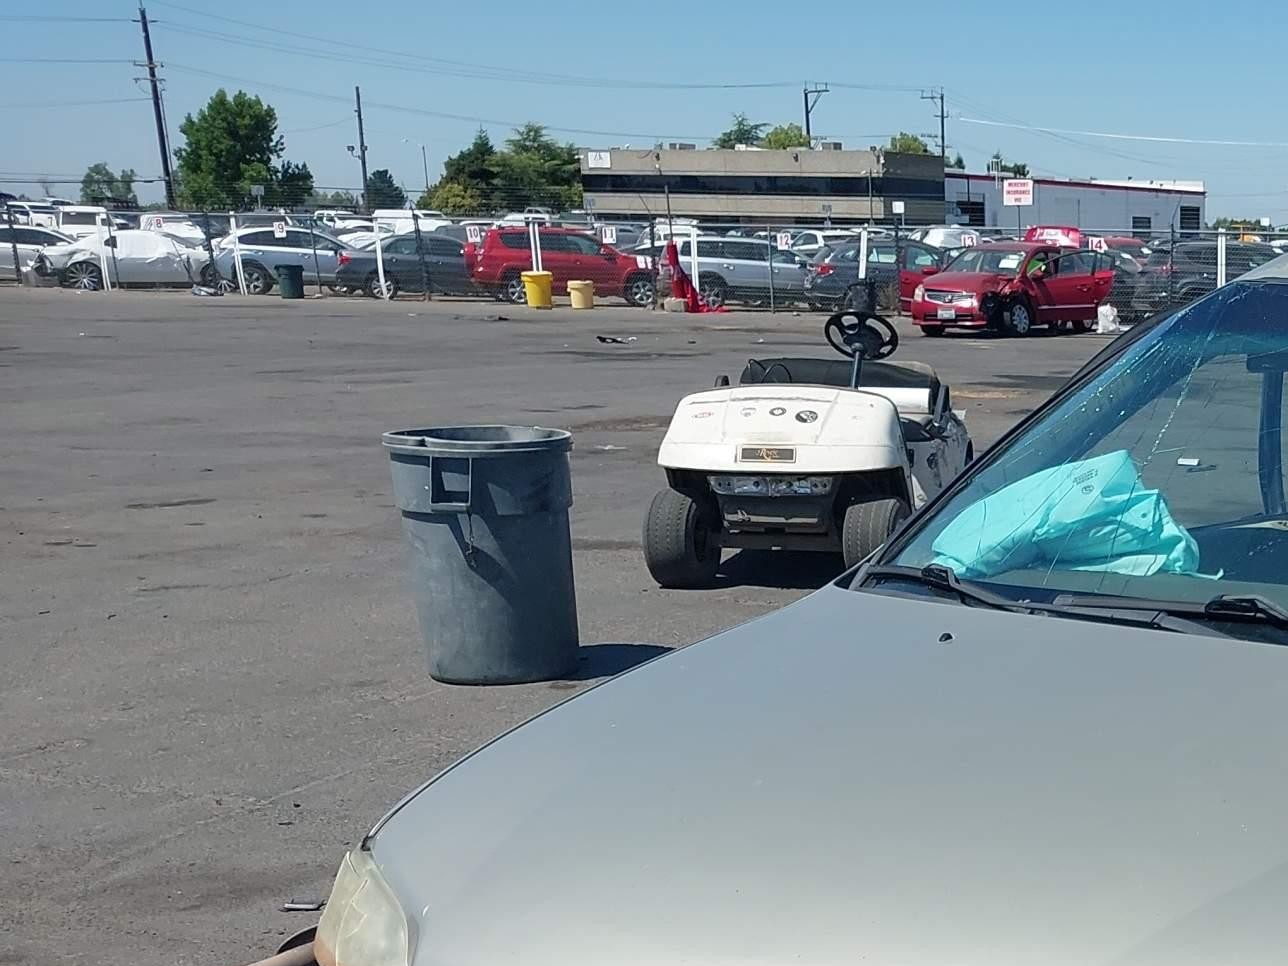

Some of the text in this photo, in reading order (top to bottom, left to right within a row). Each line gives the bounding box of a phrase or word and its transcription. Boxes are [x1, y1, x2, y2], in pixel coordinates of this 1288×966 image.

[156, 218, 162, 228] 8
[277, 223, 284, 233] 9
[468, 228, 479, 239] 10
[603, 228, 613, 239] 11
[780, 234, 790, 246] 12
[963, 236, 975, 248] 13
[1090, 239, 1102, 250] 14
